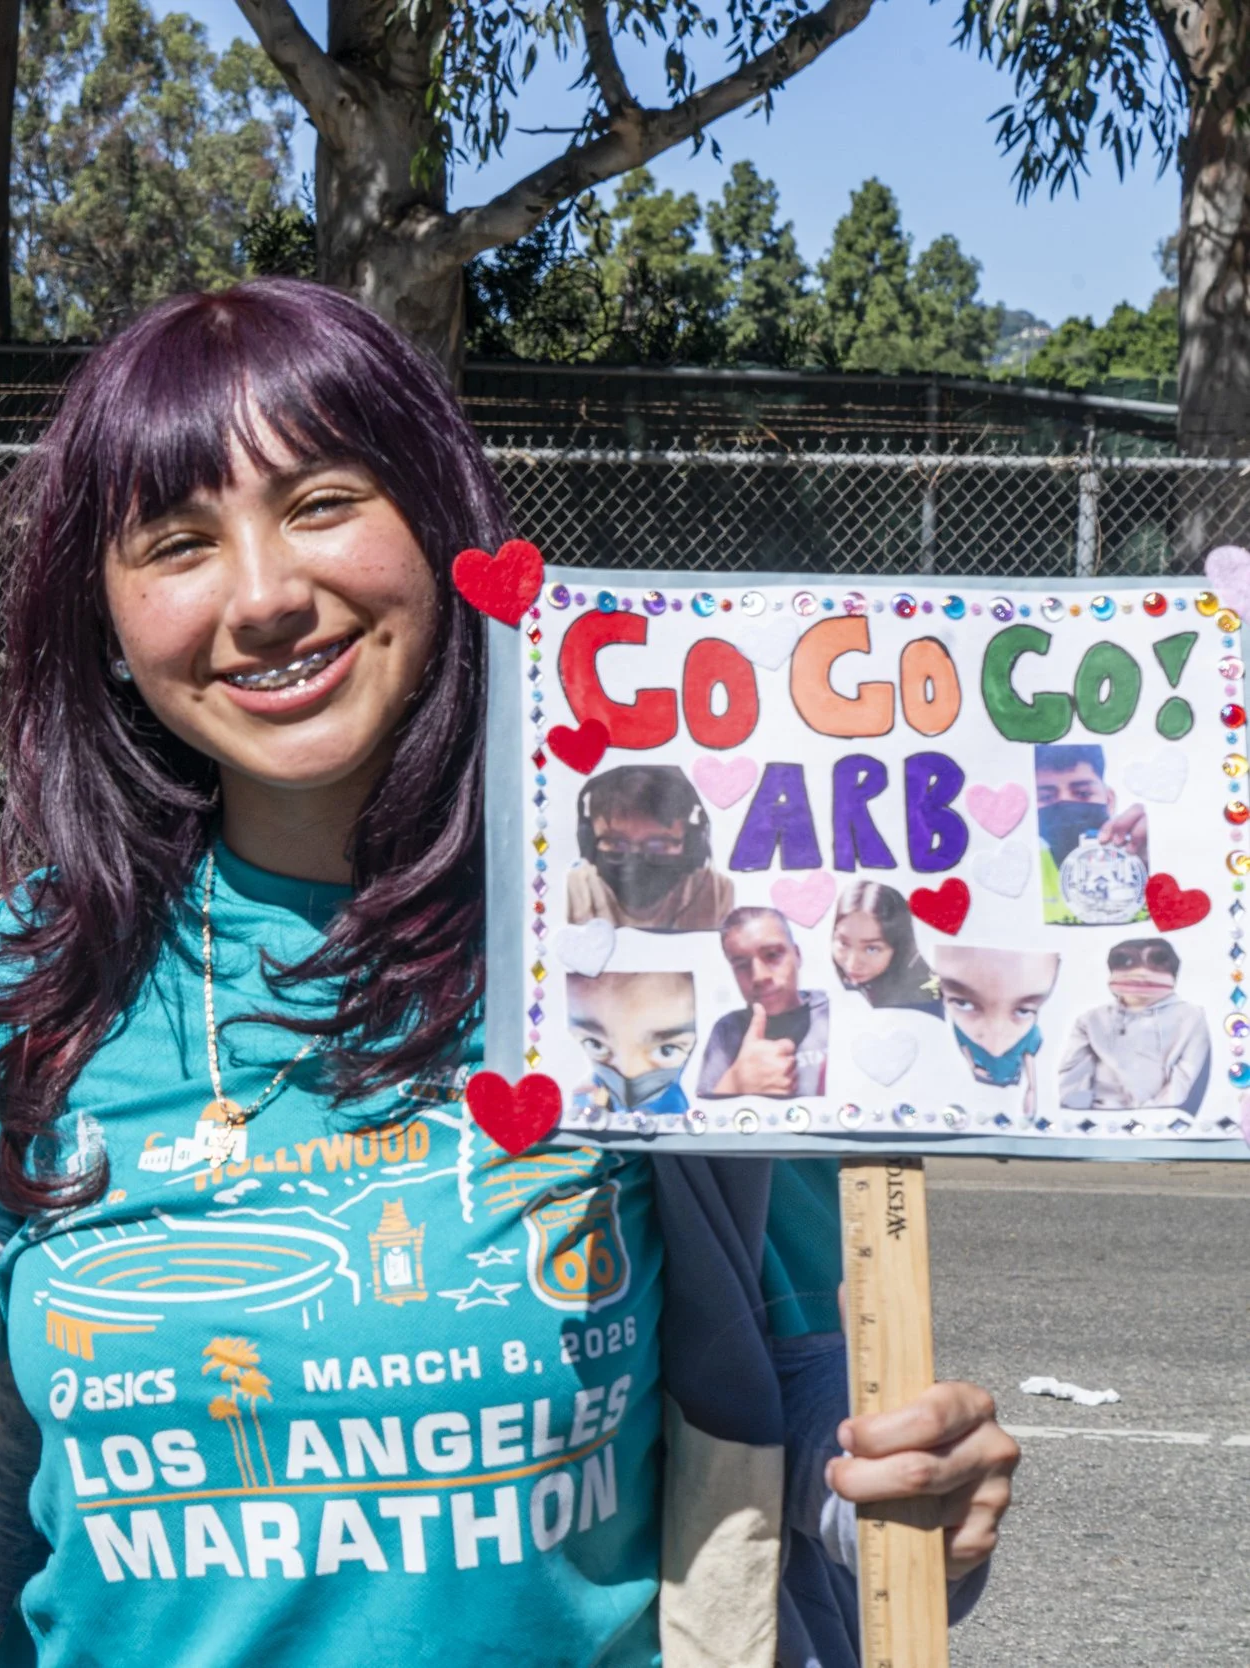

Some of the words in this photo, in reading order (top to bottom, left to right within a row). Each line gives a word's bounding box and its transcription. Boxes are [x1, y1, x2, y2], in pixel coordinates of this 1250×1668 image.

[558, 609, 759, 750] GO
[790, 614, 961, 738] GO
[980, 623, 1199, 744] GO!
[729, 751, 969, 873] ARB
[302, 1346, 481, 1392] MARCH
[502, 1340, 543, 1374] 8,
[559, 1316, 636, 1364] 2026
[64, 1428, 207, 1496] LOS
[286, 1374, 632, 1480] ANGELES
[83, 1444, 618, 1582] MARATHON
